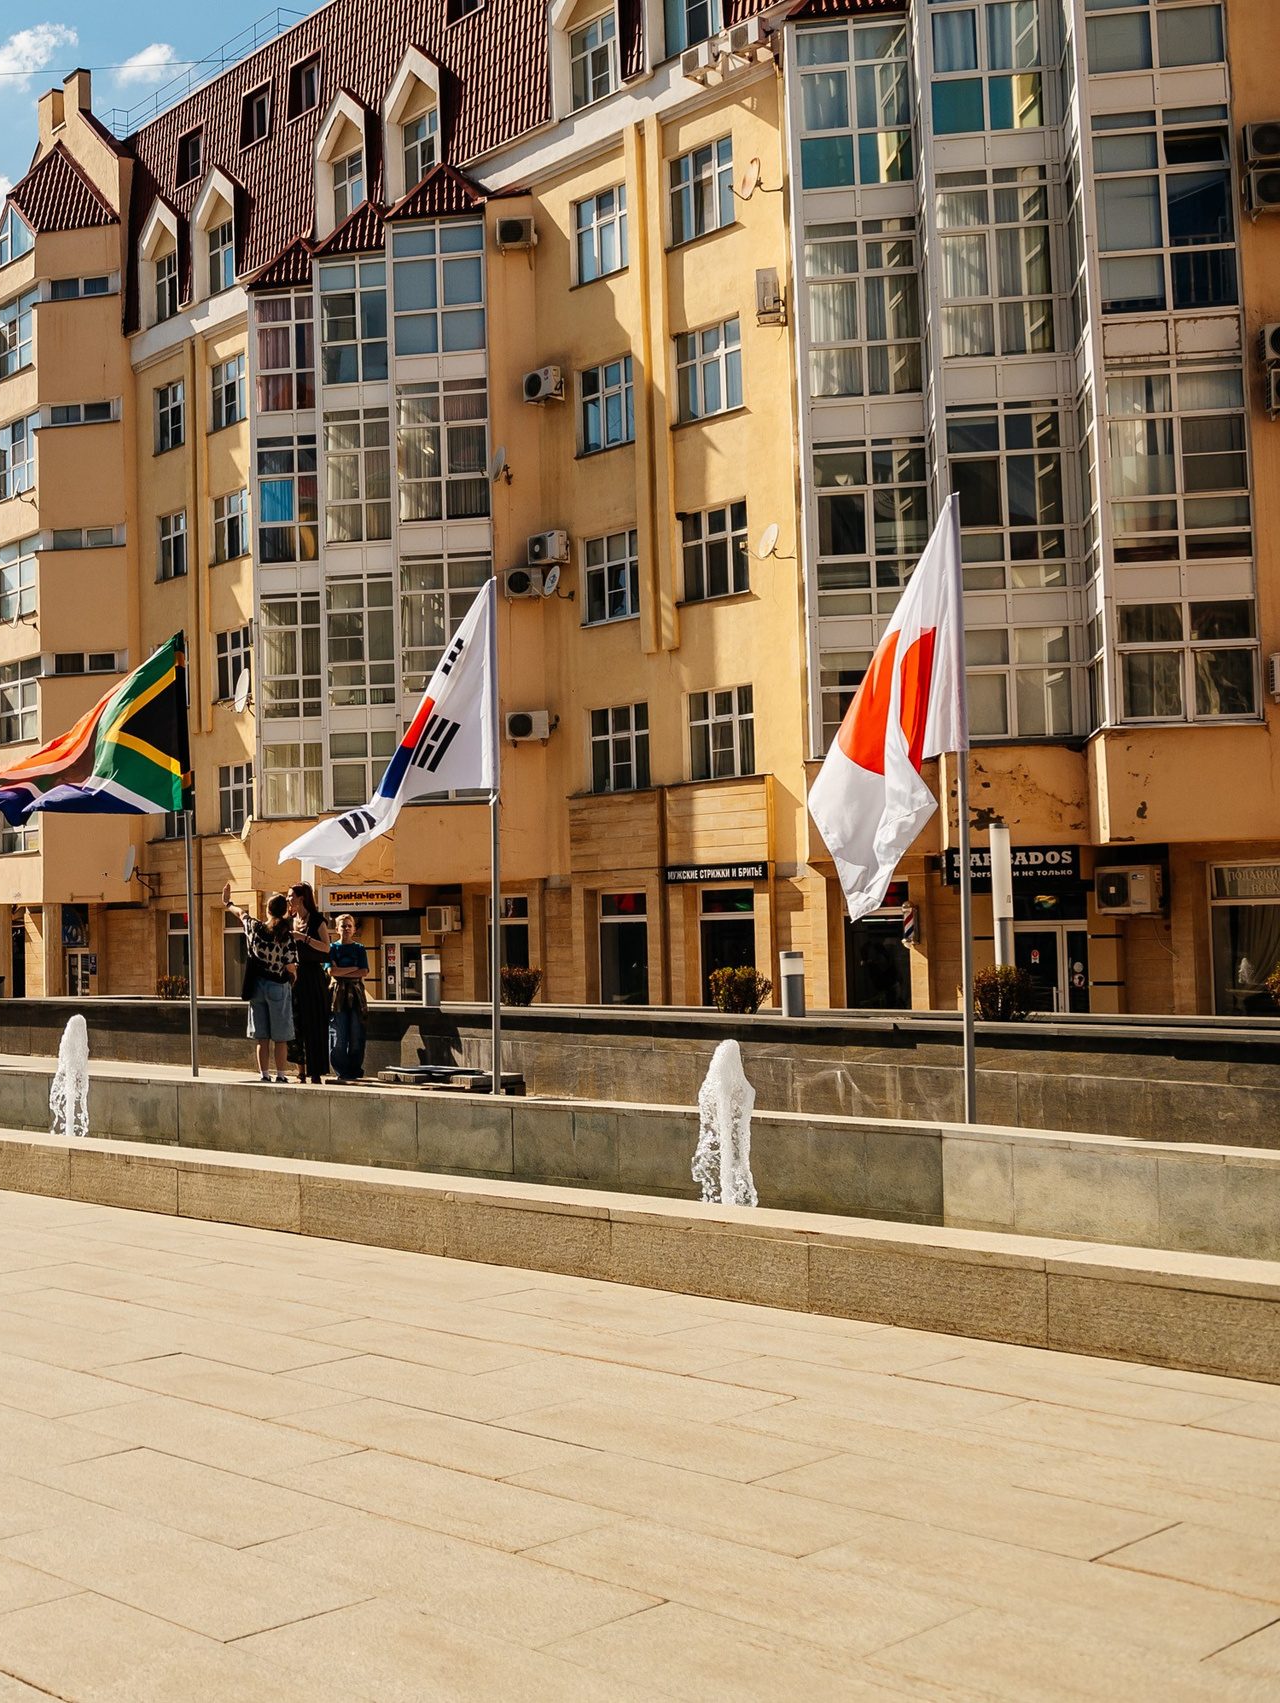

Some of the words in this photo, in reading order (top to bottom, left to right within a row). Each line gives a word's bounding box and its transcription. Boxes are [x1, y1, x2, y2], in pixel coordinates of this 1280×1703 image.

[953, 851, 1072, 866] BARADOS
[667, 870, 698, 880] МУЖСКИЕ
[700, 868, 730, 879] СТРИЖКИ
[731, 868, 736, 877] И
[330, 892, 402, 901] ТриНаЧетыре
